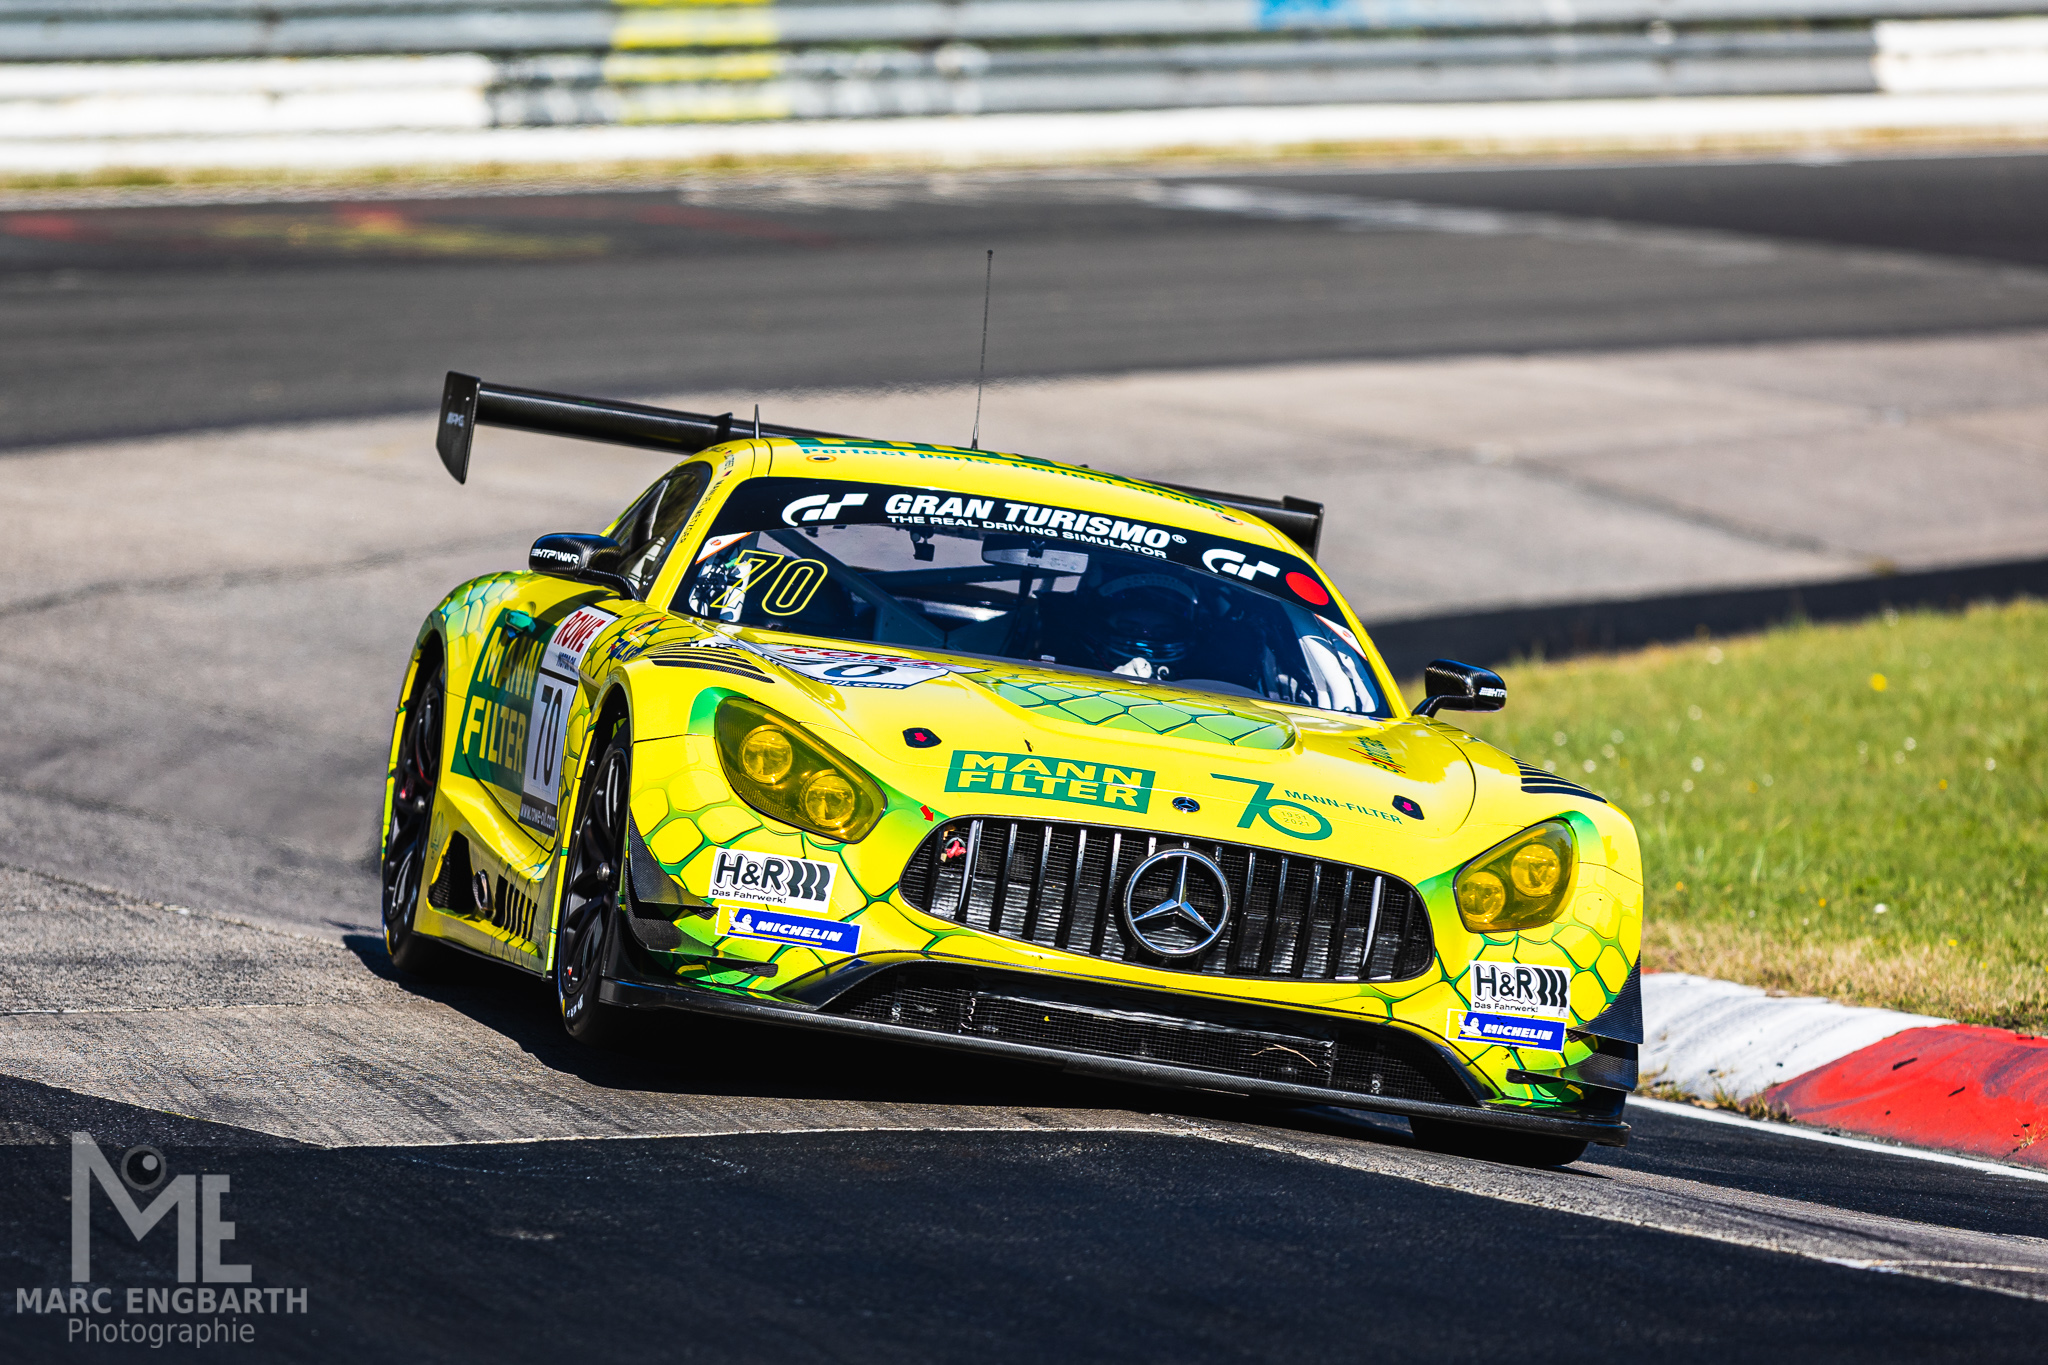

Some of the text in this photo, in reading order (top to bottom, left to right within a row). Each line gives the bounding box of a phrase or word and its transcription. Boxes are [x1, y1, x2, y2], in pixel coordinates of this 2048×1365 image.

[801, 447, 909, 457] Perfect
[885, 493, 995, 520] GRAN
[887, 515, 1168, 559] THE REAL DRIVING SIMULATOR
[710, 550, 828, 616] 70
[553, 610, 607, 653] ROWE
[477, 626, 544, 701] MANN
[462, 695, 528, 774] FILTER
[532, 684, 563, 786] 70
[957, 771, 1139, 807] FILTER
[962, 754, 1143, 789] MANN
[1284, 790, 1403, 825] MANN-FILTER
[714, 852, 790, 896] H&R
[711, 888, 787, 904] Das Fahrwerk!
[755, 920, 843, 943] MICHELIN
[1473, 964, 1537, 1005] H&R
[1474, 1001, 1539, 1013] Das Fahrwerk!
[1483, 1023, 1554, 1041] MICHELIN
